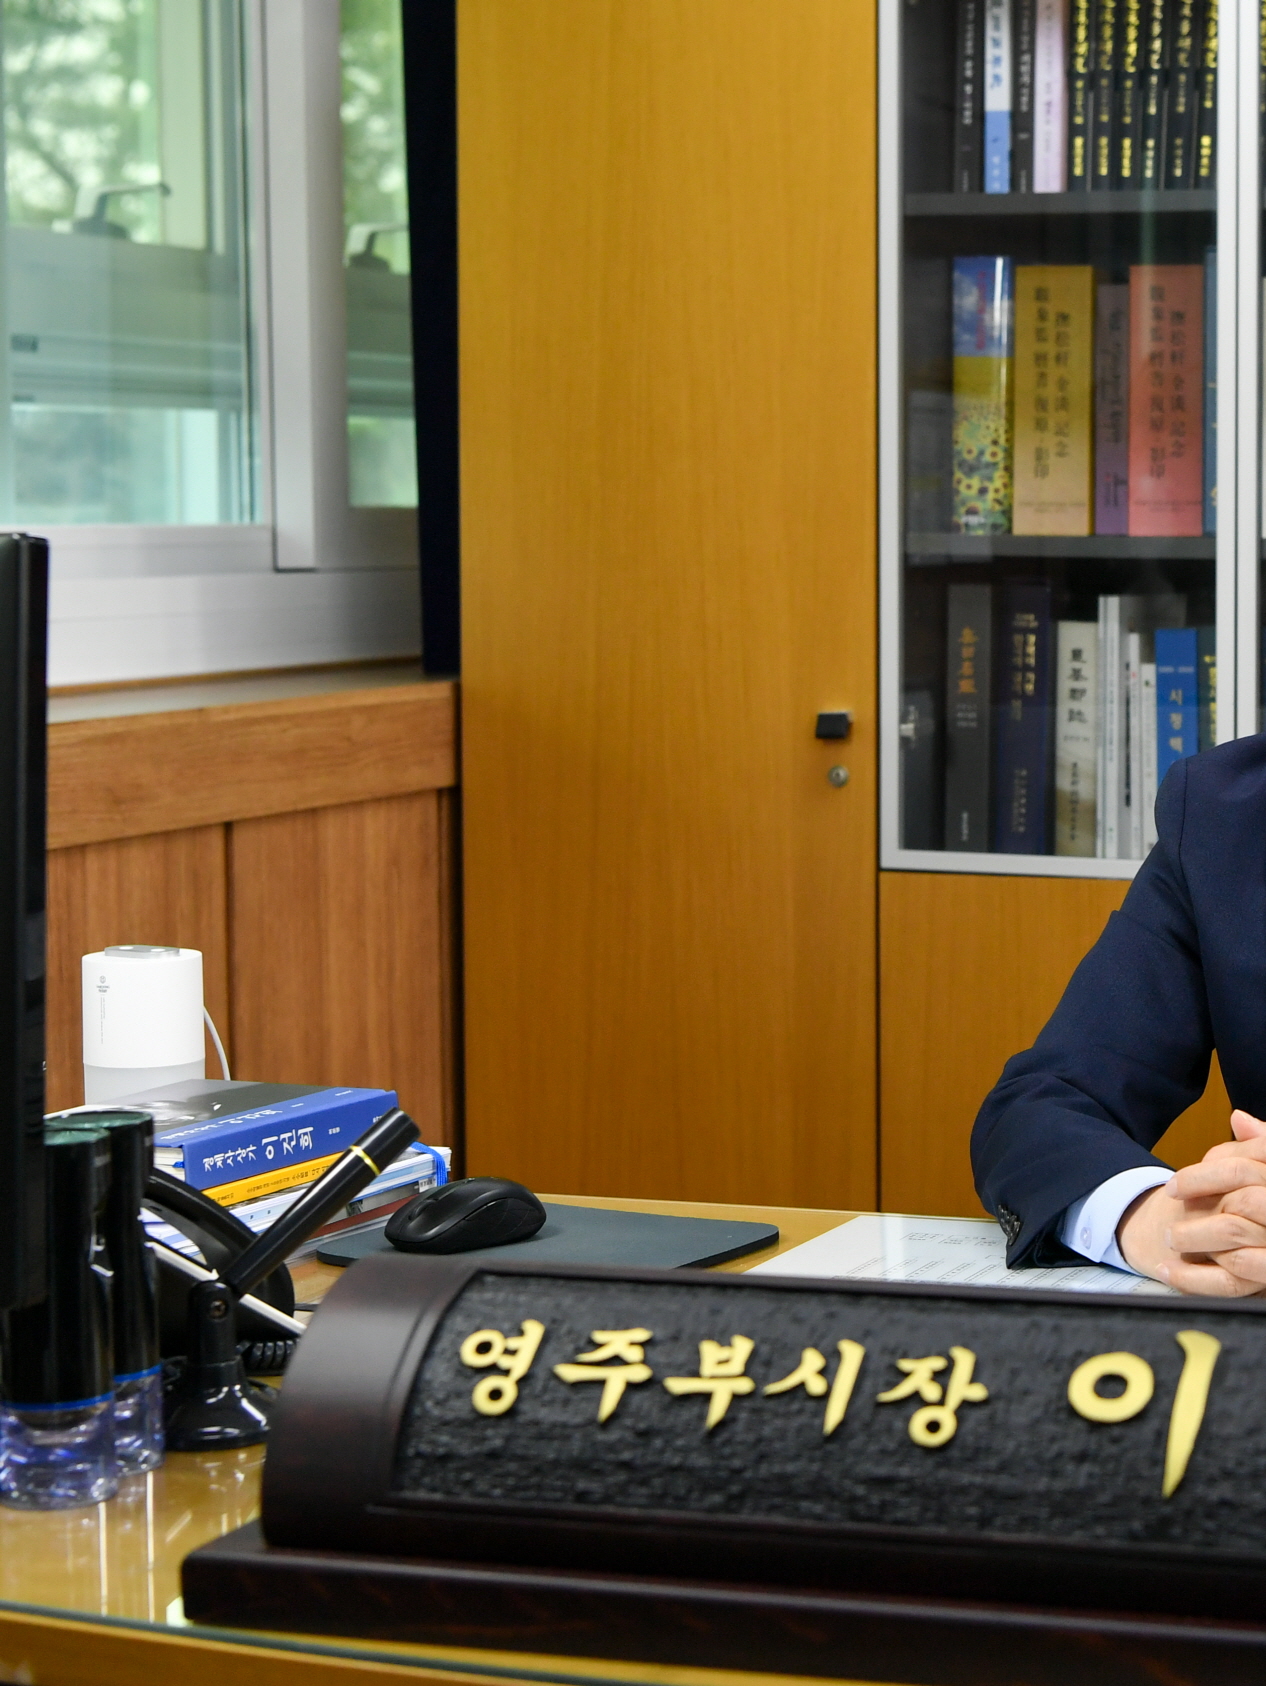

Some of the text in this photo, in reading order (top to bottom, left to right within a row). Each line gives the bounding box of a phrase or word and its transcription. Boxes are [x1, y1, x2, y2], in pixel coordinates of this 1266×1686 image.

[203, 1126, 314, 1172] 경제사상가 이건희
[459, 1318, 989, 1448] 영주부시장
